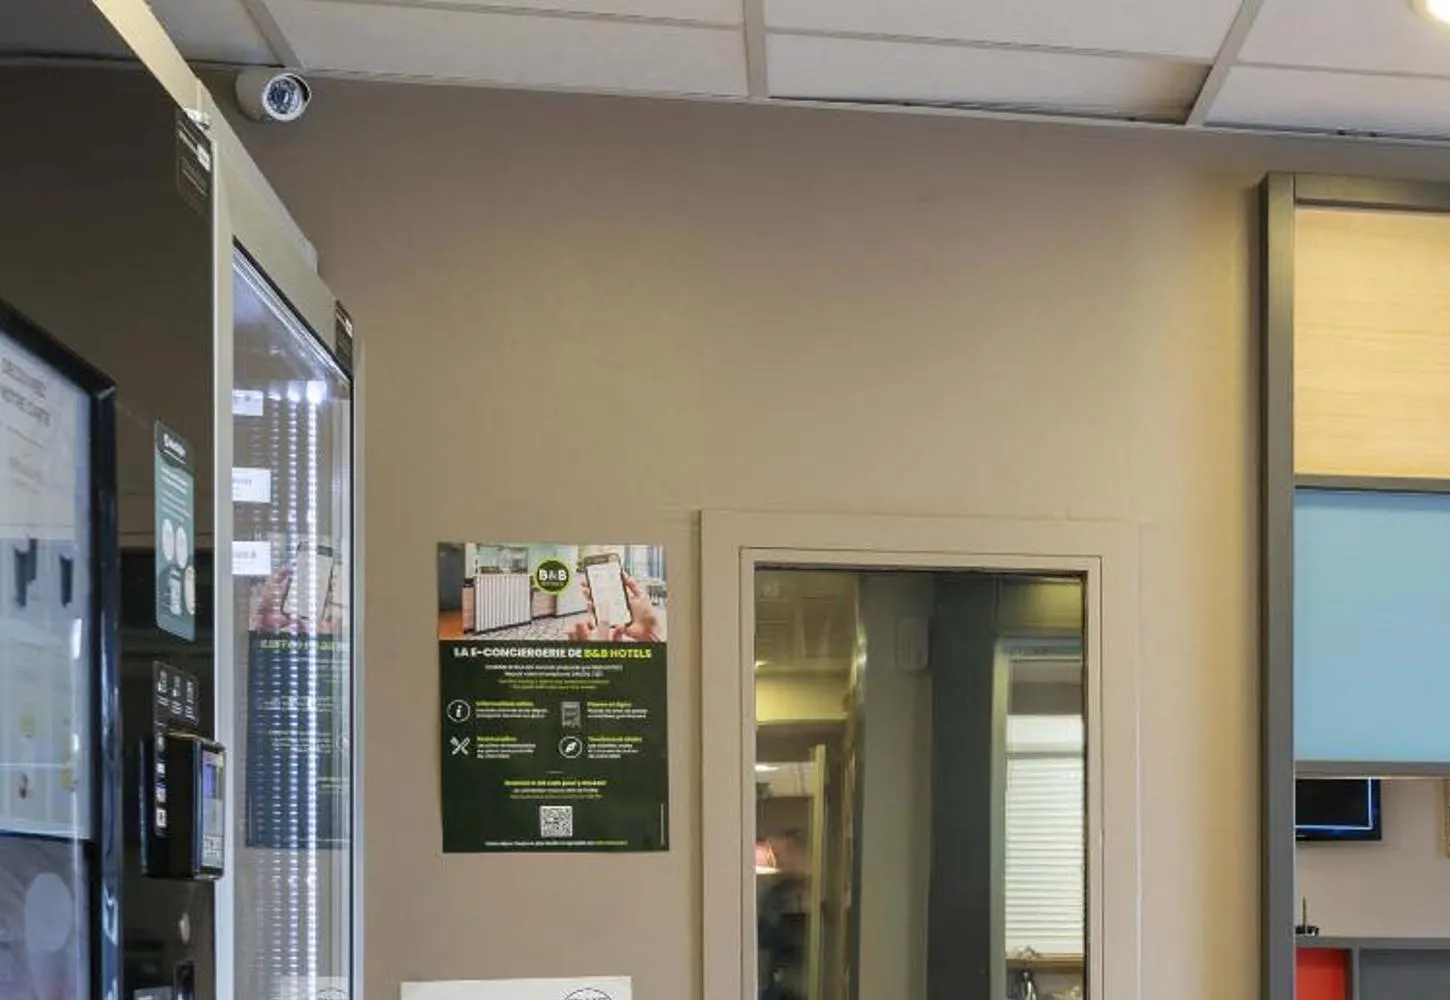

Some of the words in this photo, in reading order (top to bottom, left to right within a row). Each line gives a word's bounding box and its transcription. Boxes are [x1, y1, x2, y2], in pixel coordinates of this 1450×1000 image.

[453, 647, 469, 657] LA
[567, 648, 582, 658] DE
[583, 648, 608, 658] B&B
[610, 648, 652, 658] HOTELS
